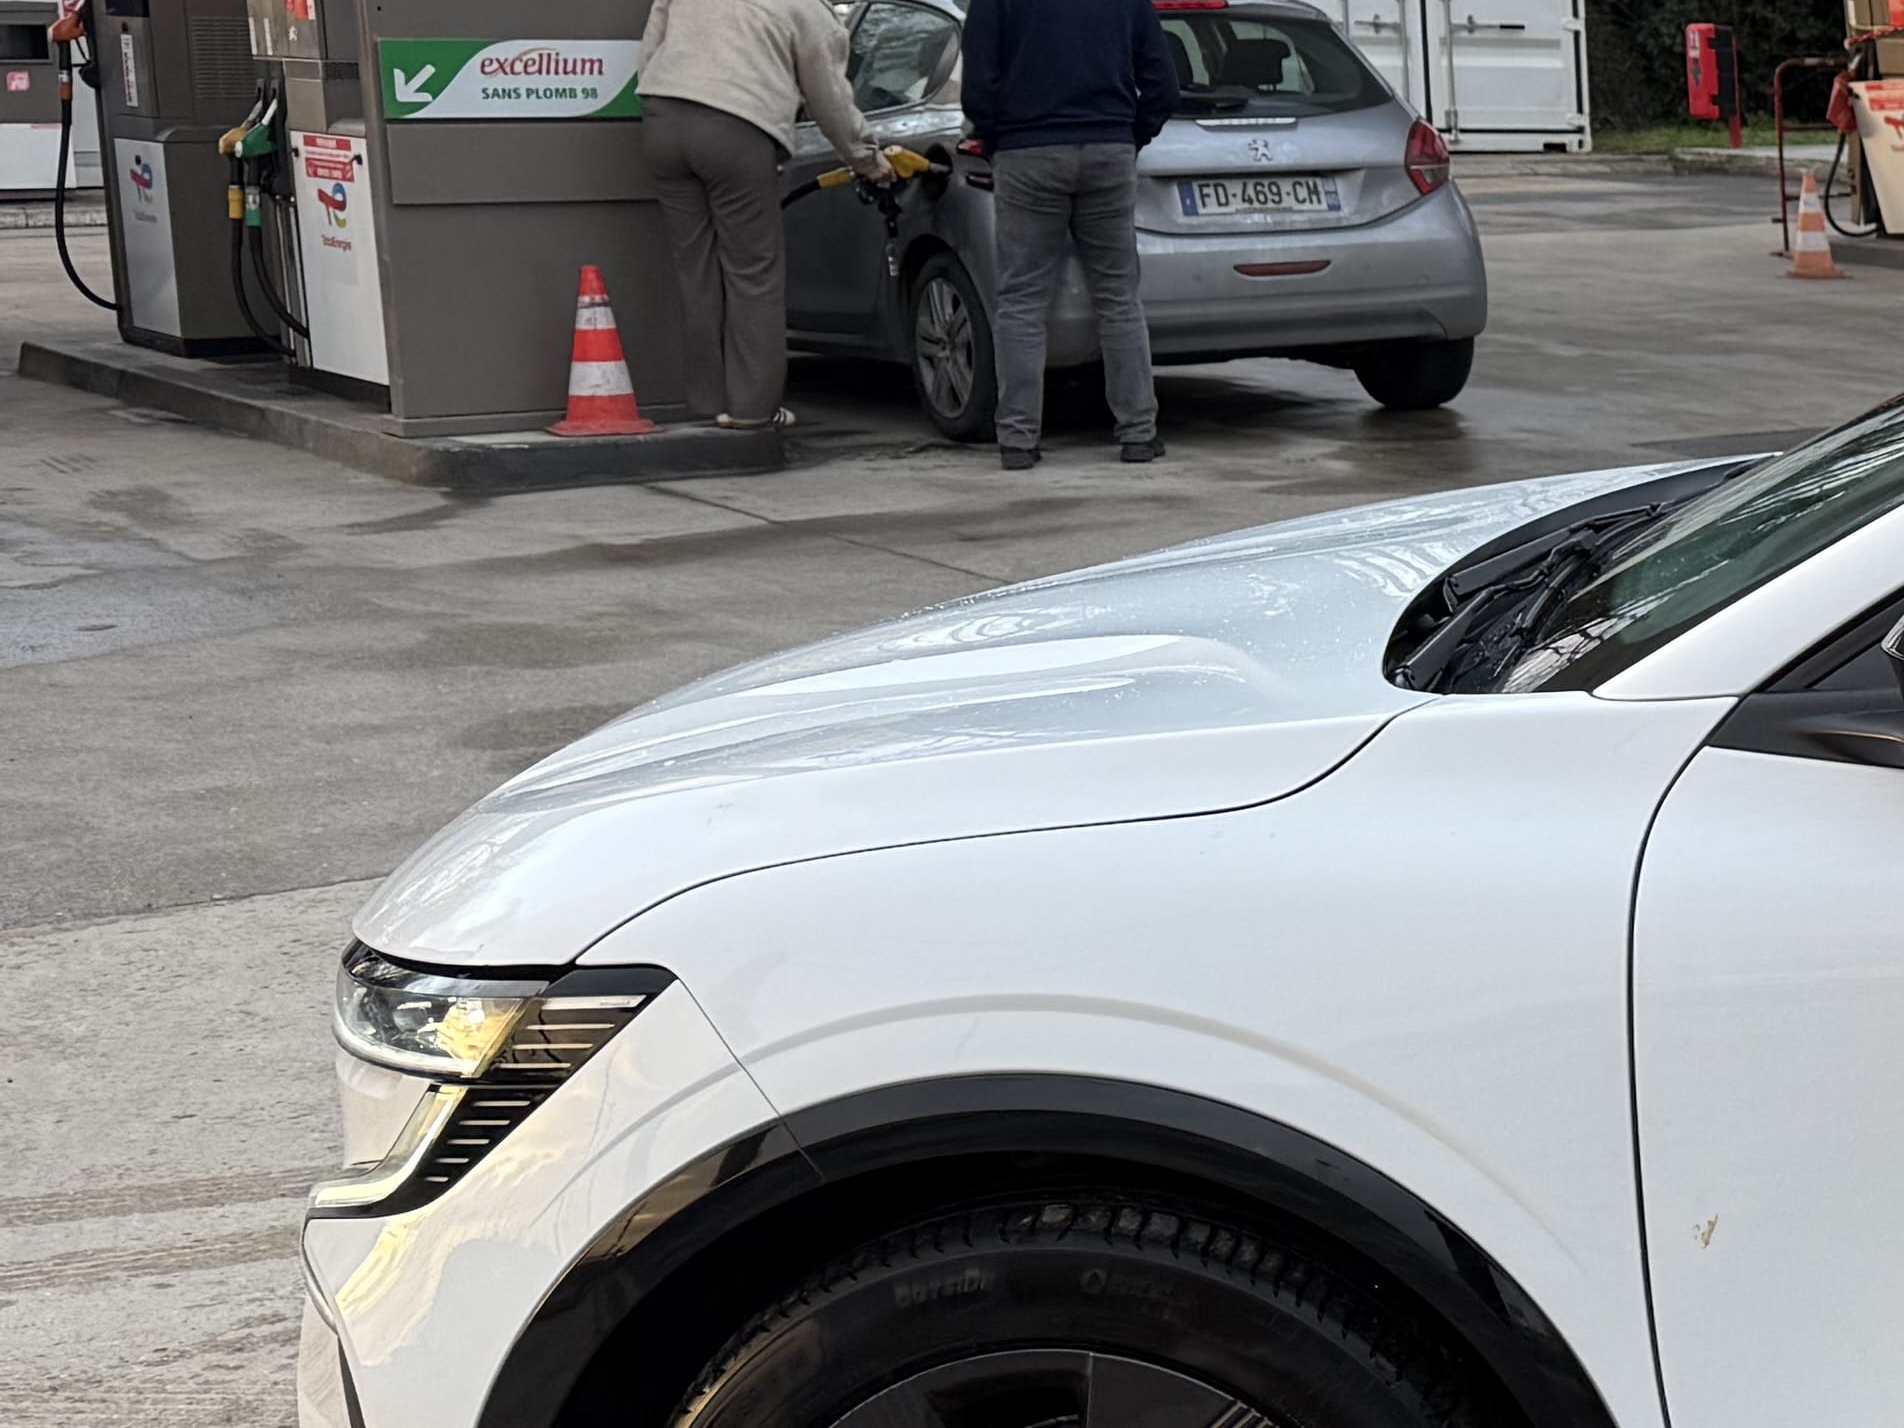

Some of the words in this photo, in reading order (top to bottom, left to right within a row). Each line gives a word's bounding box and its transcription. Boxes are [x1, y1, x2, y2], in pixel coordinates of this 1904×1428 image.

[480, 52, 604, 76] excellium
[481, 87, 521, 100] SANS
[526, 87, 577, 100] PLOMB
[581, 87, 598, 100] 98
